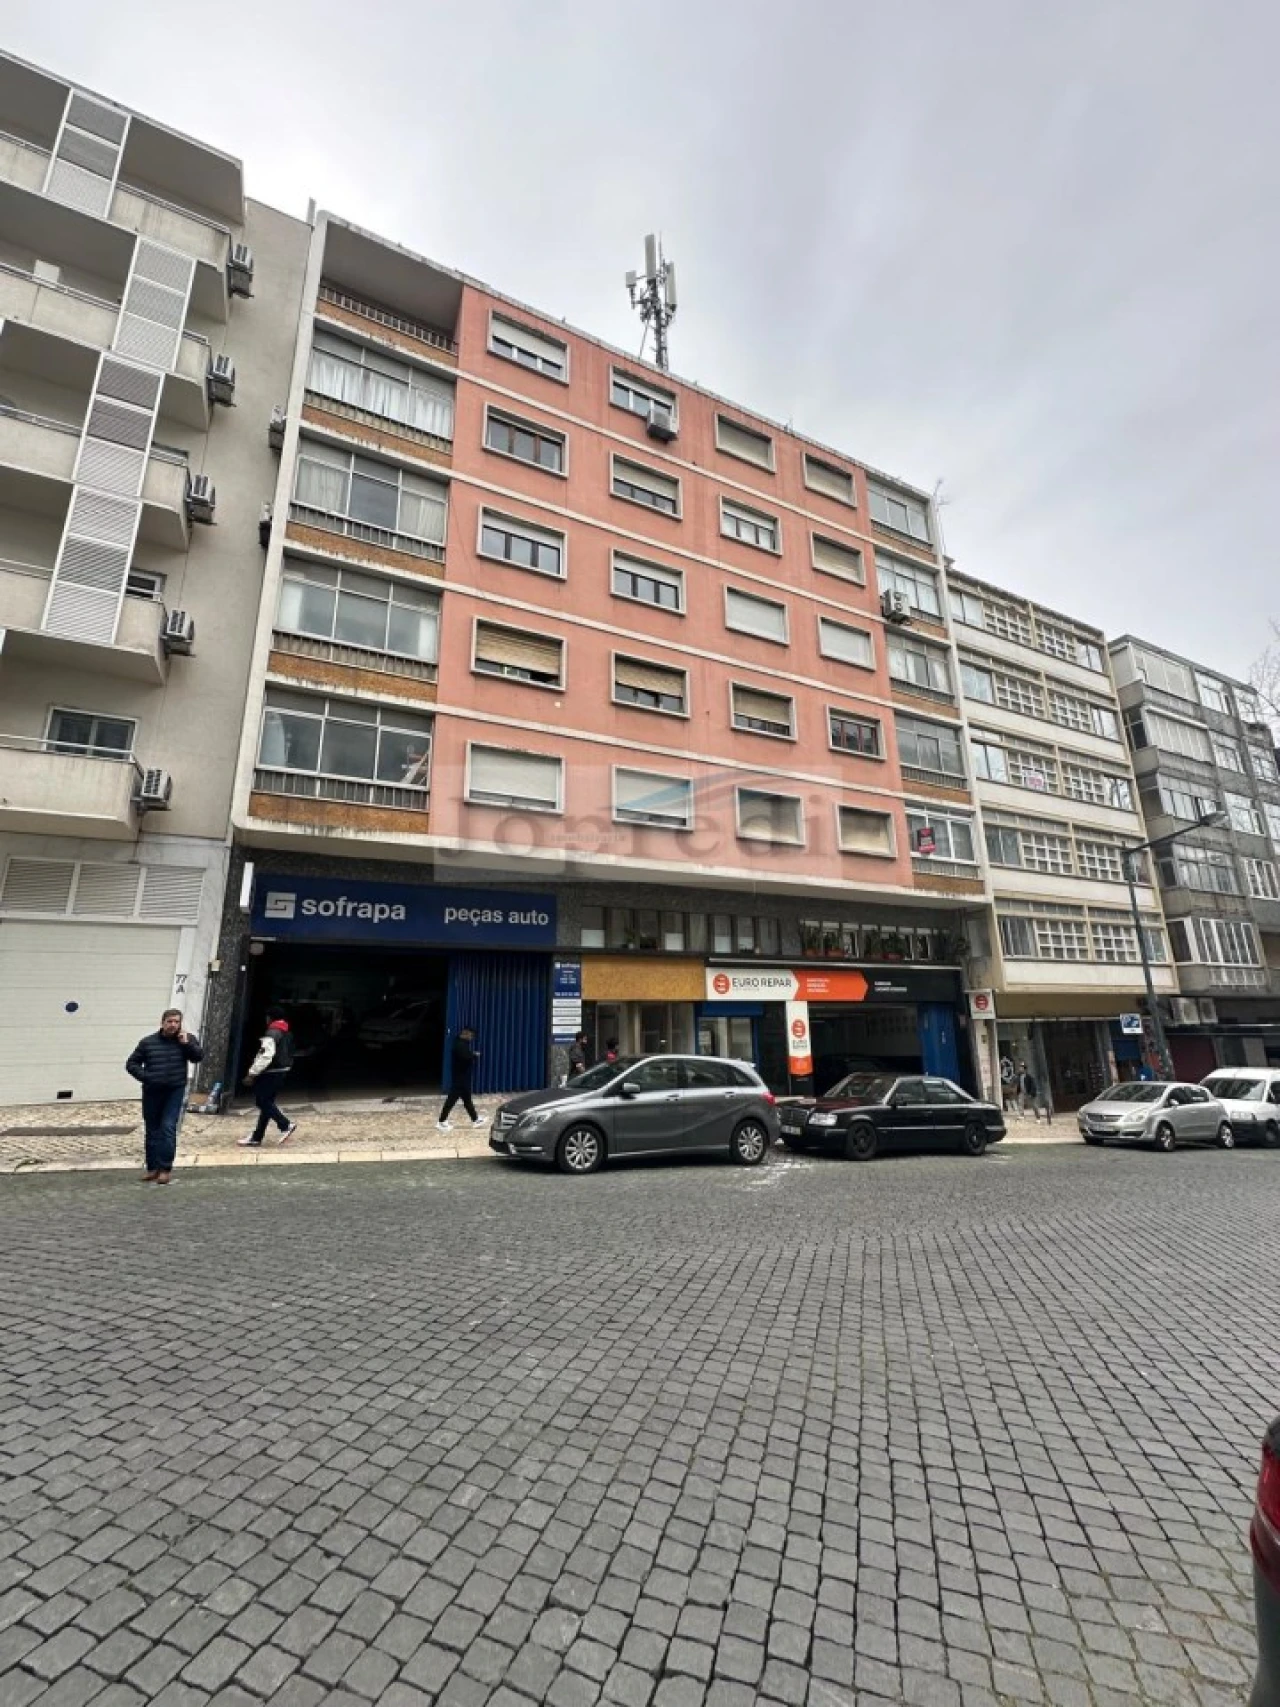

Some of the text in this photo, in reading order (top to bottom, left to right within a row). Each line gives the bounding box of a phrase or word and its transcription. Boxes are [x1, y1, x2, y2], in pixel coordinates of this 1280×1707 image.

[301, 895, 407, 924] sofrapa
[444, 906, 550, 927] peças auto
[175, 973, 188, 984] 77
[732, 977, 792, 988] EURO REPAR
[175, 984, 186, 995] A
